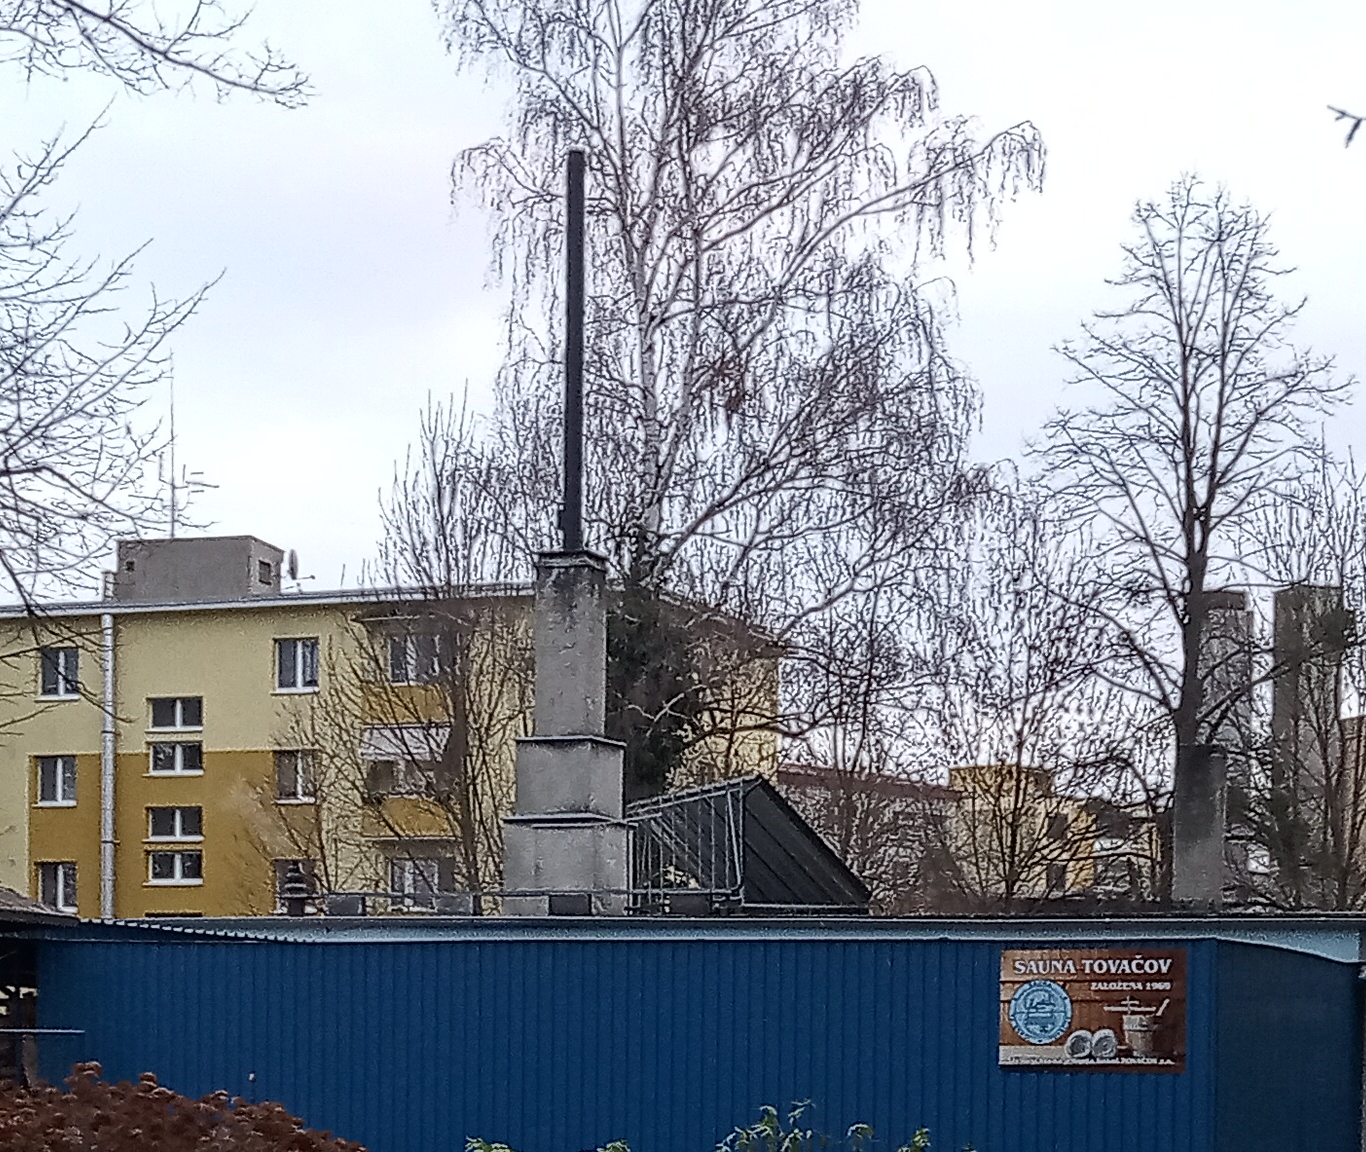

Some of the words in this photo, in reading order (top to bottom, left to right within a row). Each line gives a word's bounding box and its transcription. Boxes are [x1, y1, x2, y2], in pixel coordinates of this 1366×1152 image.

[1013, 958, 1077, 975] SAUNA
[1081, 954, 1173, 975] TOVAČOV
[1090, 979, 1143, 991] ZALOŽENA
